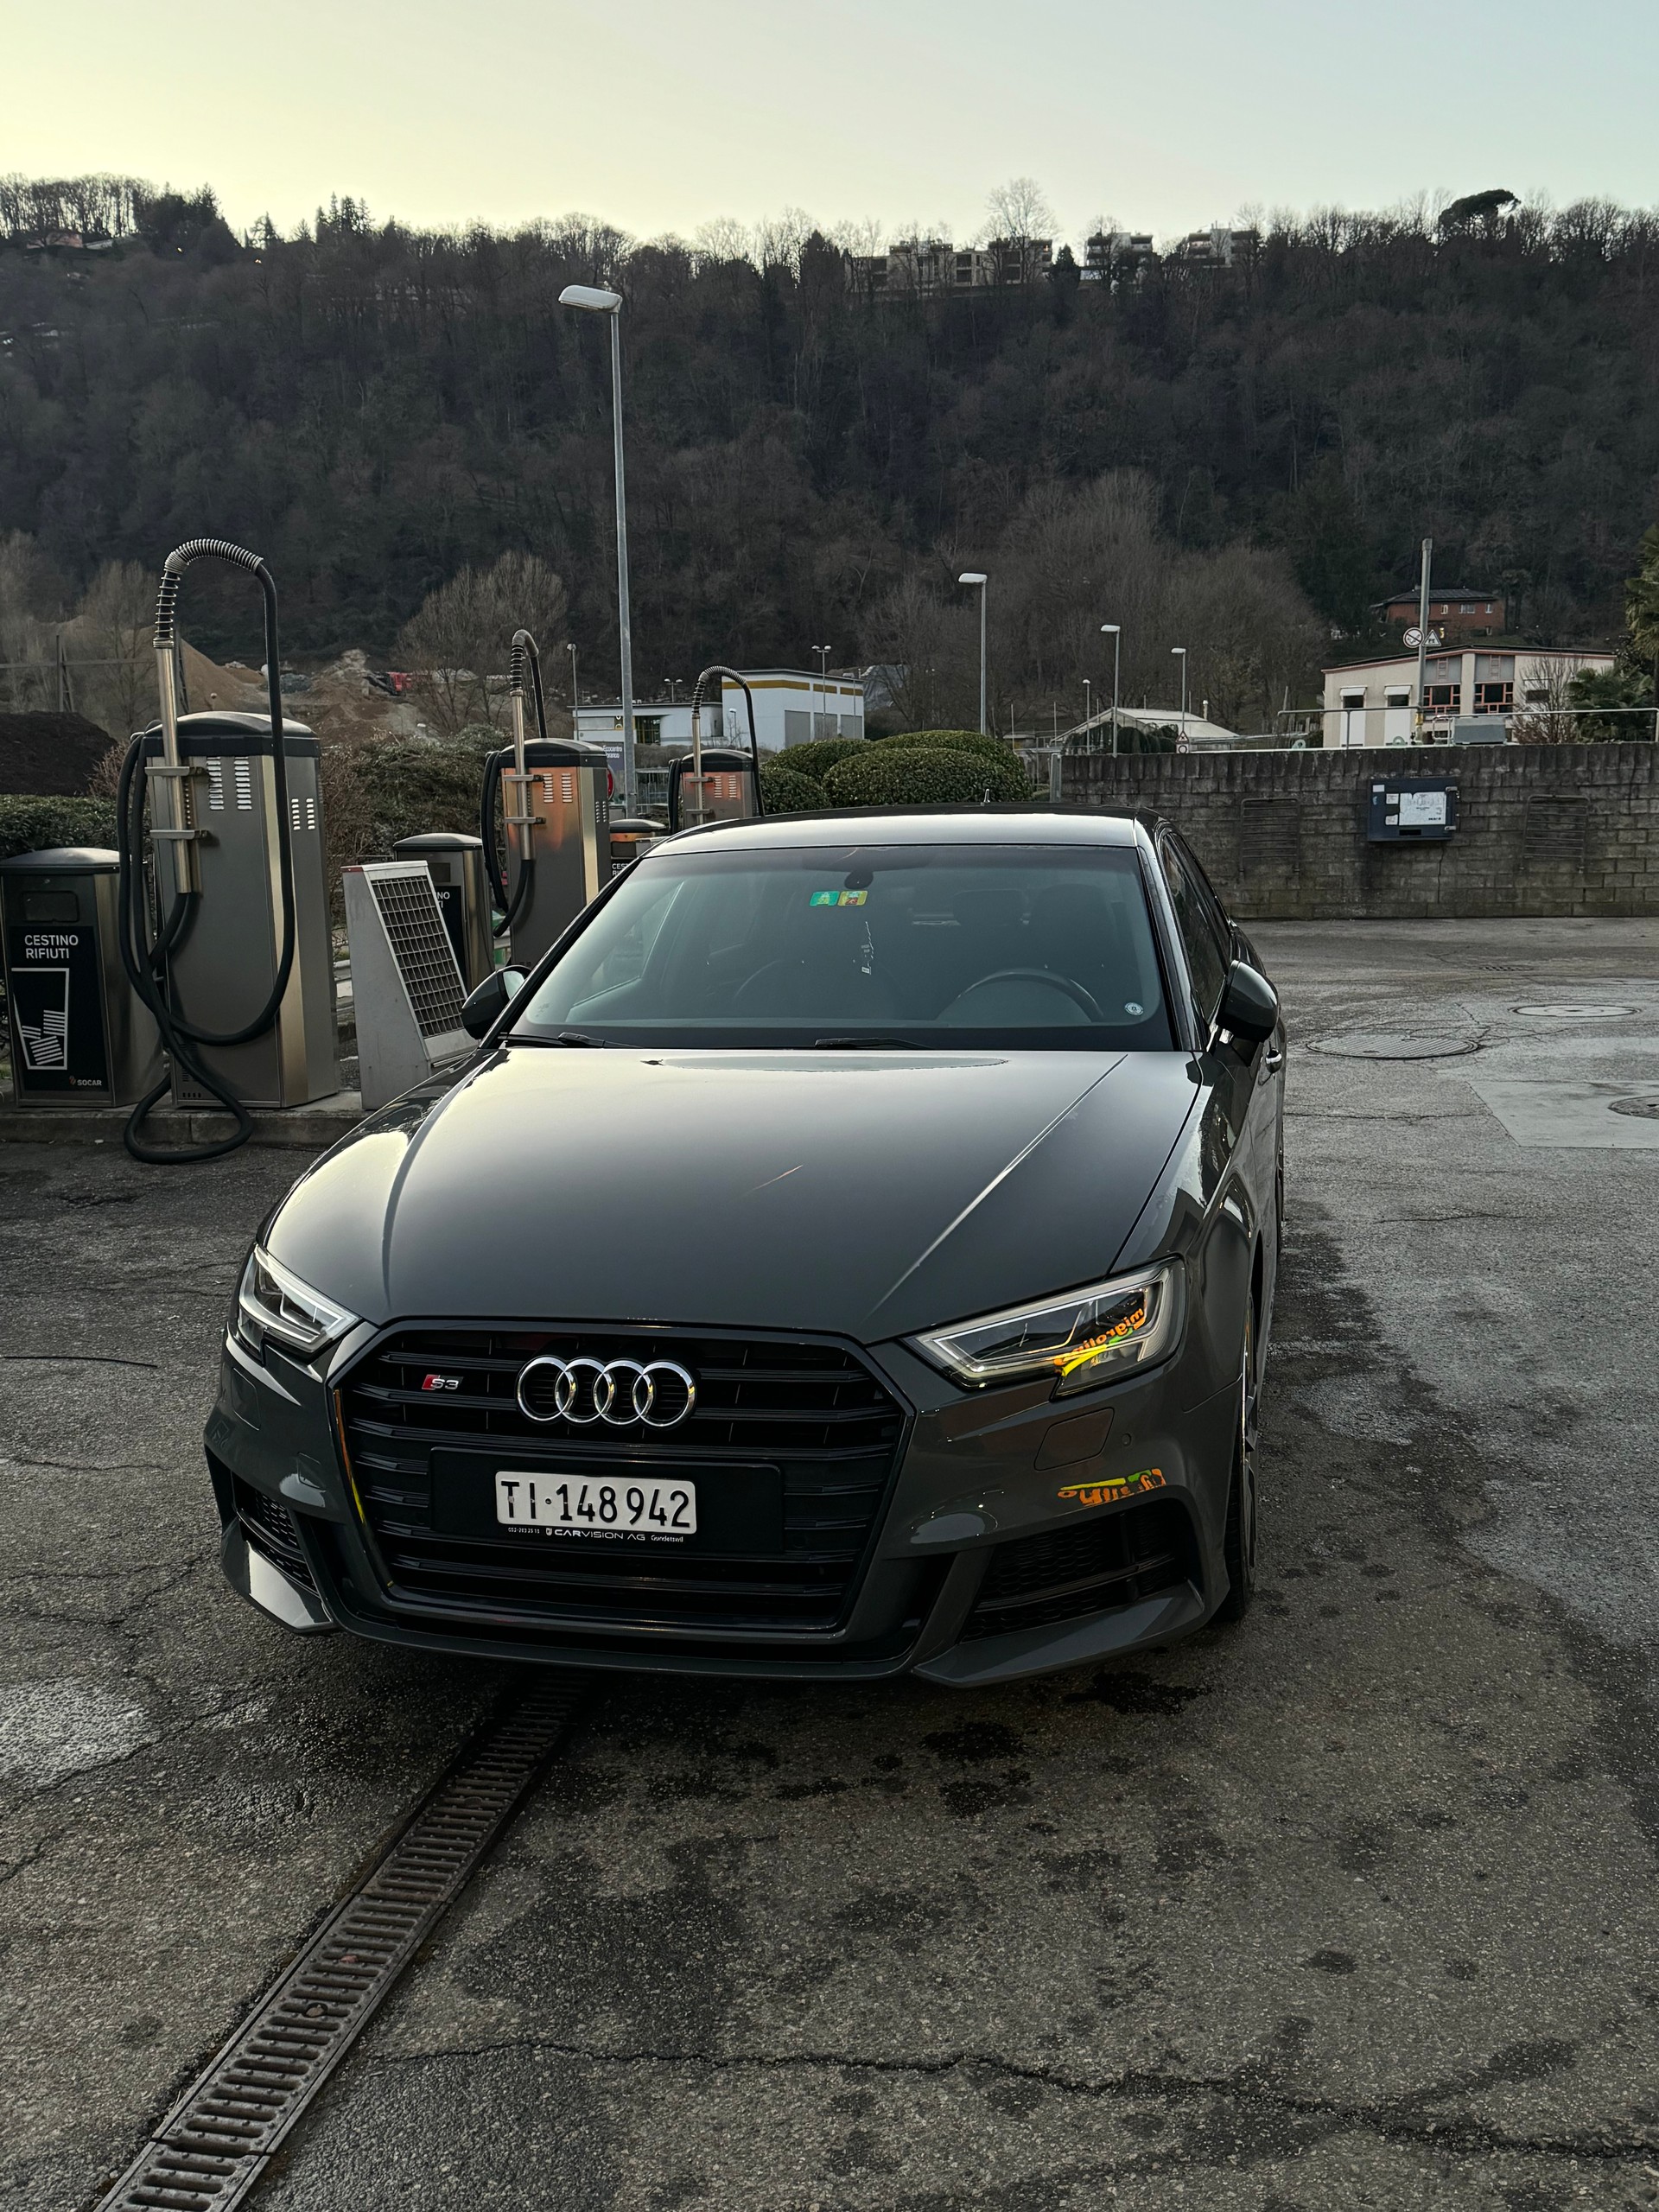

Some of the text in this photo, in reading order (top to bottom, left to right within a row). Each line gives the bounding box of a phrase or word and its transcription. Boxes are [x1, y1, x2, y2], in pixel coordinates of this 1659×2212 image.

[24, 935, 79, 945] CESTINO
[25, 948, 70, 959] RIFIUTI
[431, 1378, 460, 1390] S3
[554, 1529, 624, 1540] CARVISION
